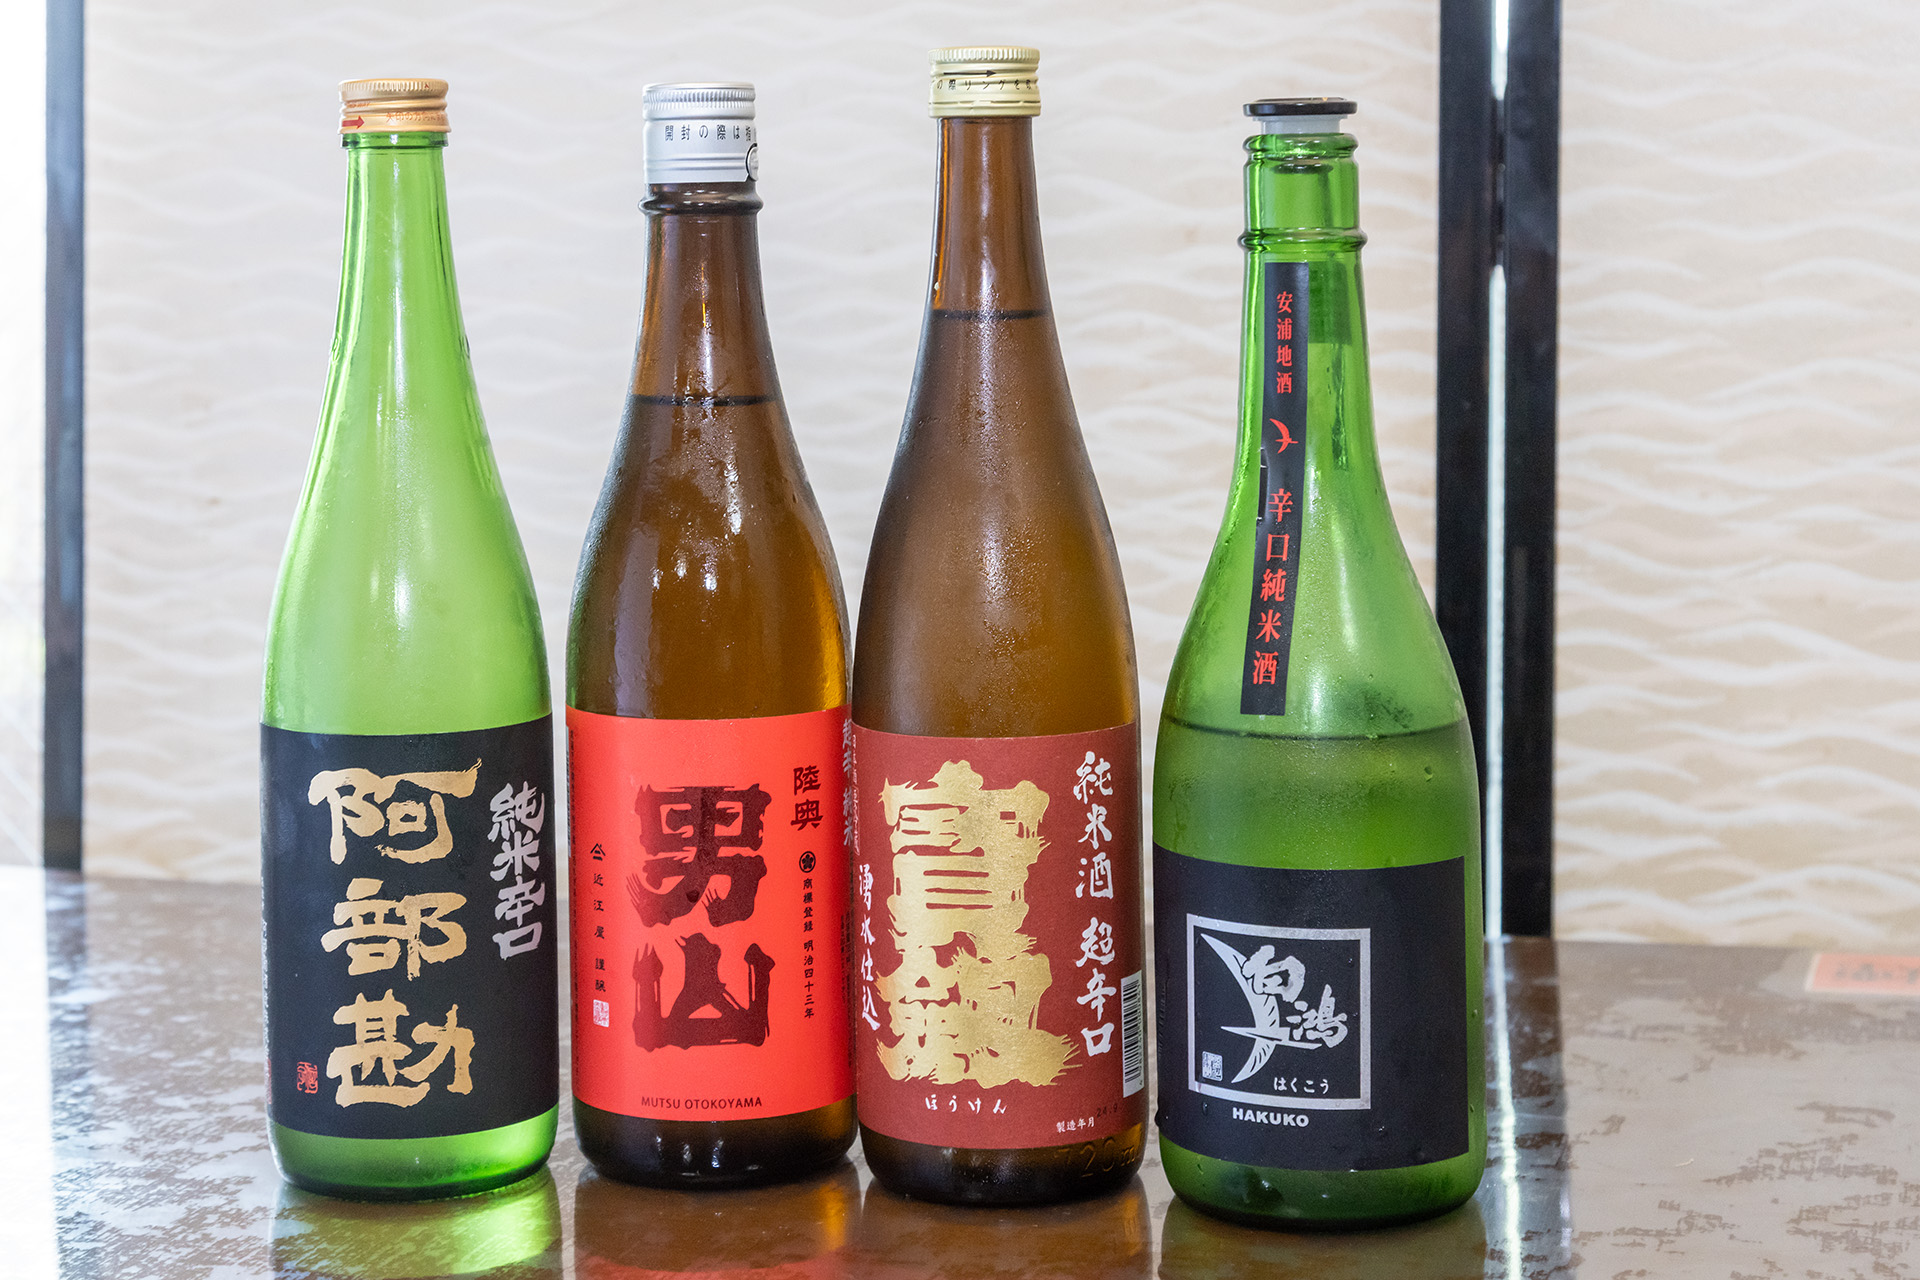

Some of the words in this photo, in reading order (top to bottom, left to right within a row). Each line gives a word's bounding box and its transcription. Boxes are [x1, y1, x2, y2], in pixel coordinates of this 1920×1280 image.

[1276, 291, 1293, 394] 安浦地酒
[1252, 489, 1294, 686] 辛口純米酒
[487, 781, 545, 961] 純米辛口
[1073, 750, 1114, 900] 純米酒
[307, 757, 483, 1108] 阿部勘
[593, 873, 605, 939] 近江屋
[626, 783, 776, 1052] 男山
[803, 878, 814, 932] 商標登録
[858, 863, 882, 1031] 湧水仕込
[803, 939, 815, 1019] 明治四十三年
[1074, 916, 1117, 1057] 超辛口
[1242, 945, 1349, 1049] 白鴻
[641, 1096, 681, 1109] MUTSU
[684, 1096, 763, 1110] OTOKOYAMA
[925, 1093, 1008, 1114] ほうけん
[1056, 1116, 1095, 1133] 製造年月
[1232, 1106, 1310, 1128] HAKUKO
[1273, 1076, 1330, 1095] はくこう
